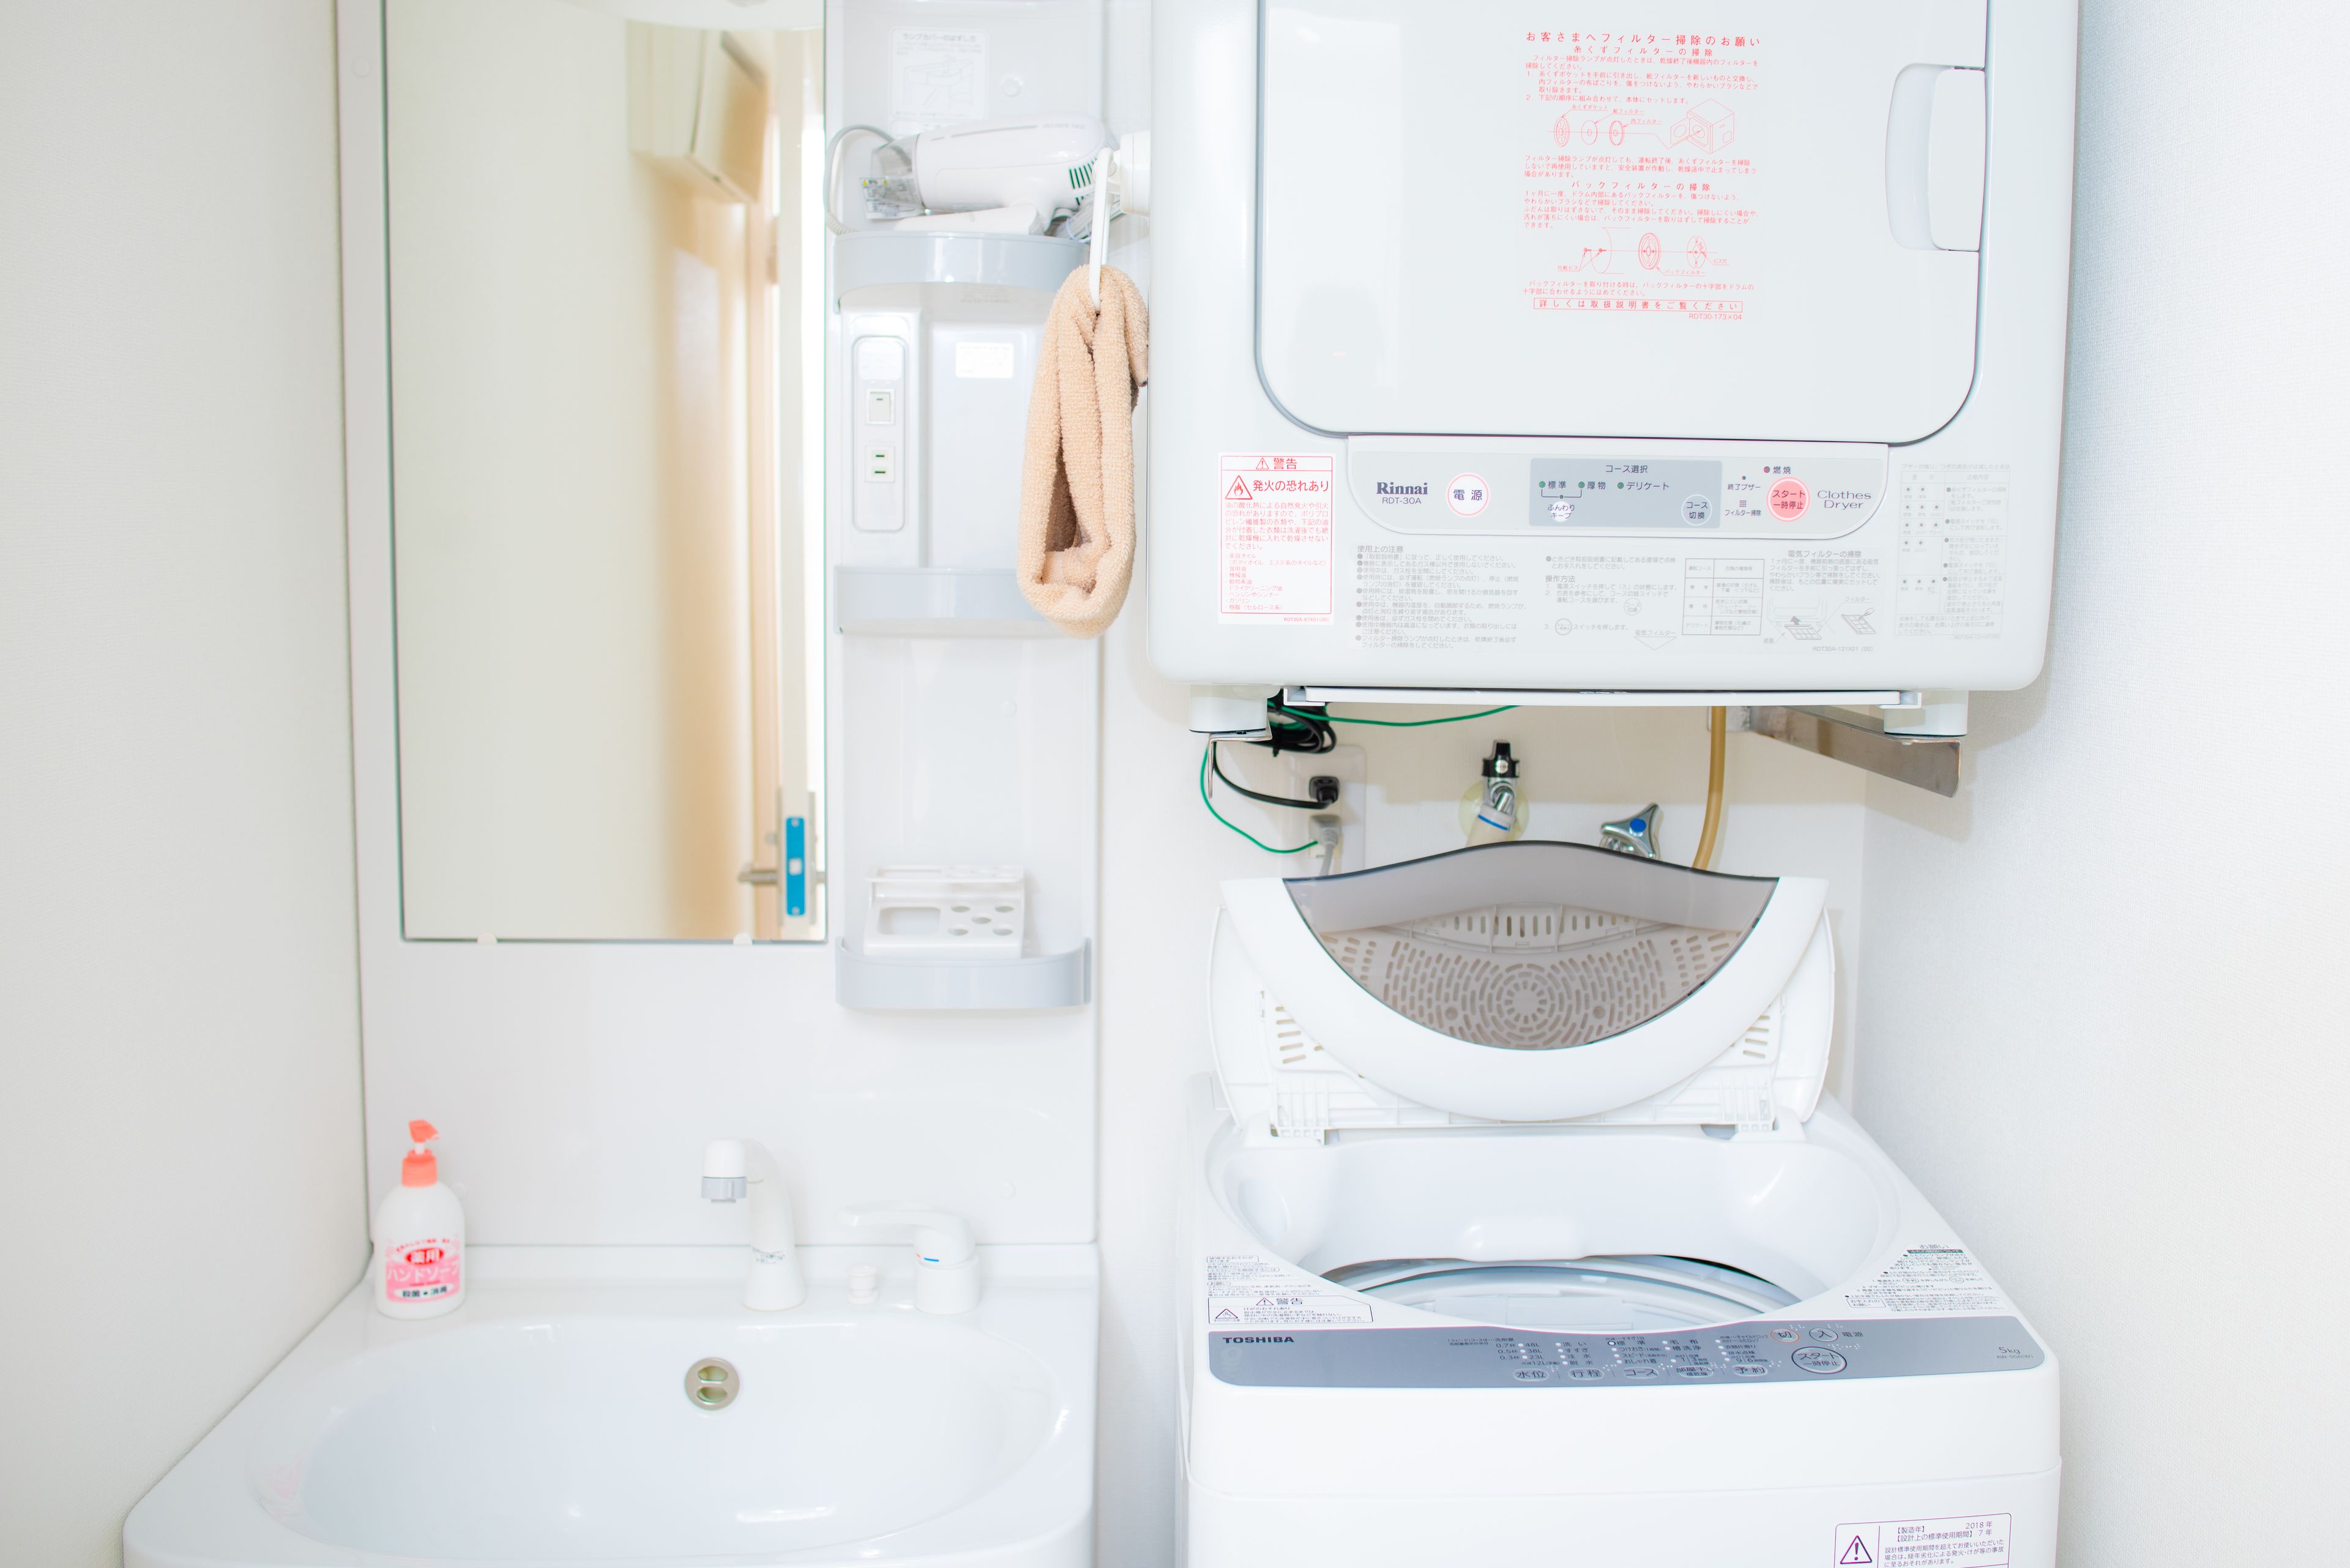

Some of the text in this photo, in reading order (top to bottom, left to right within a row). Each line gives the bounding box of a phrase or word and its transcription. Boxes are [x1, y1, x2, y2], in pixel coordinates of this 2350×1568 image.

[1526, 31, 1760, 47] お客さまへフィルター掃除のお願い
[1574, 46, 1714, 57] 糸くずフィルターの掃除
[1572, 182, 1711, 192] バックフィルターの掃除
[1539, 300, 1737, 310] 詳しくは取扱説明書をご覧ください
[1274, 458, 1297, 469] 警告
[1605, 464, 1647, 474] コース選択
[1253, 480, 1329, 491] 発火の恐れあり
[1376, 482, 1428, 495] Rinnai
[1548, 480, 1606, 490] 標準 厚物
[1627, 482, 1669, 490] デリケート
[1453, 489, 1482, 501] 電源
[1772, 490, 1806, 498] スタート
[1818, 490, 1871, 499] Clothes
[1824, 500, 1863, 510] Dryer
[1897, 1531, 1973, 1542] 【設計上の標準使用期間】
[1885, 1539, 2004, 1553] 設計標準使用期間を超えてお使いいただいた
[1885, 1547, 2004, 1561] 場合は、経年劣化による発火・けが等の事故
[1884, 1559, 1954, 1568] に至るおそれがあります。
